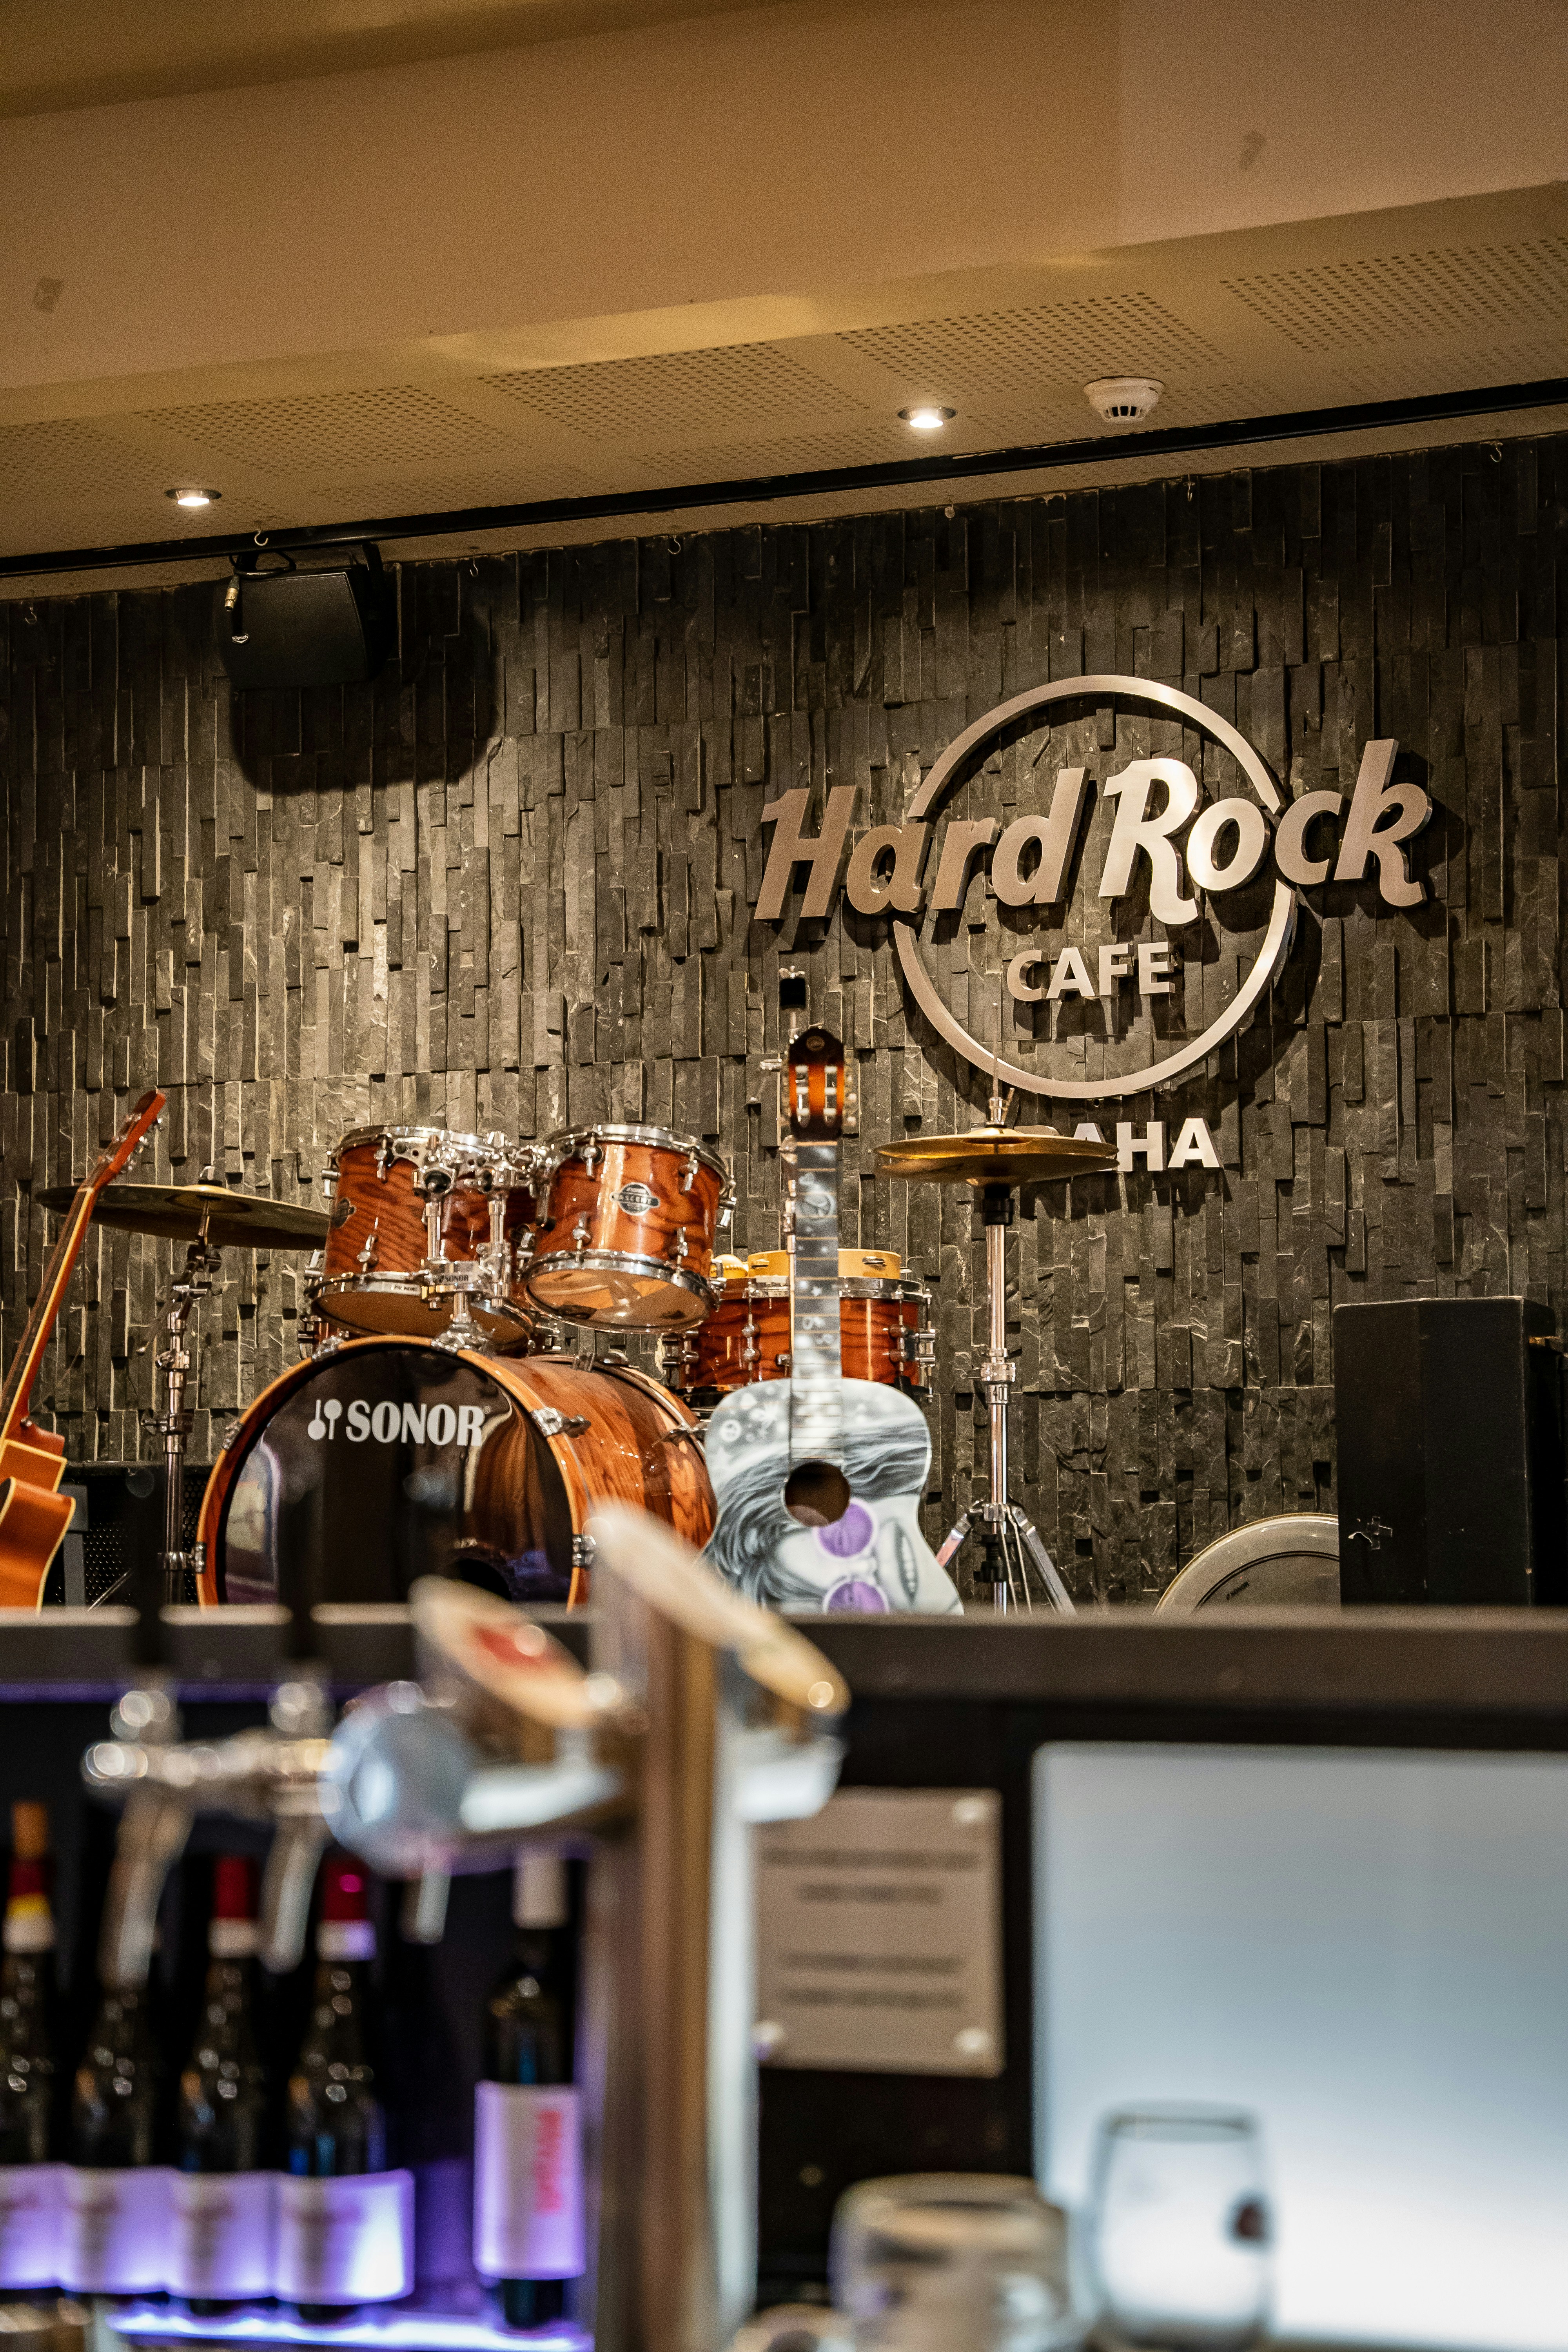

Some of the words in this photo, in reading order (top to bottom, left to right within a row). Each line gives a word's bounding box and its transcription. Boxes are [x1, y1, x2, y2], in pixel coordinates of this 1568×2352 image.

[754, 767, 1090, 920] Hard
[1098, 739, 1432, 925] Rock
[1007, 941, 1175, 1002] CAFE
[619, 1194, 652, 1205] ASCET
[346, 1399, 485, 1446] SONOR
